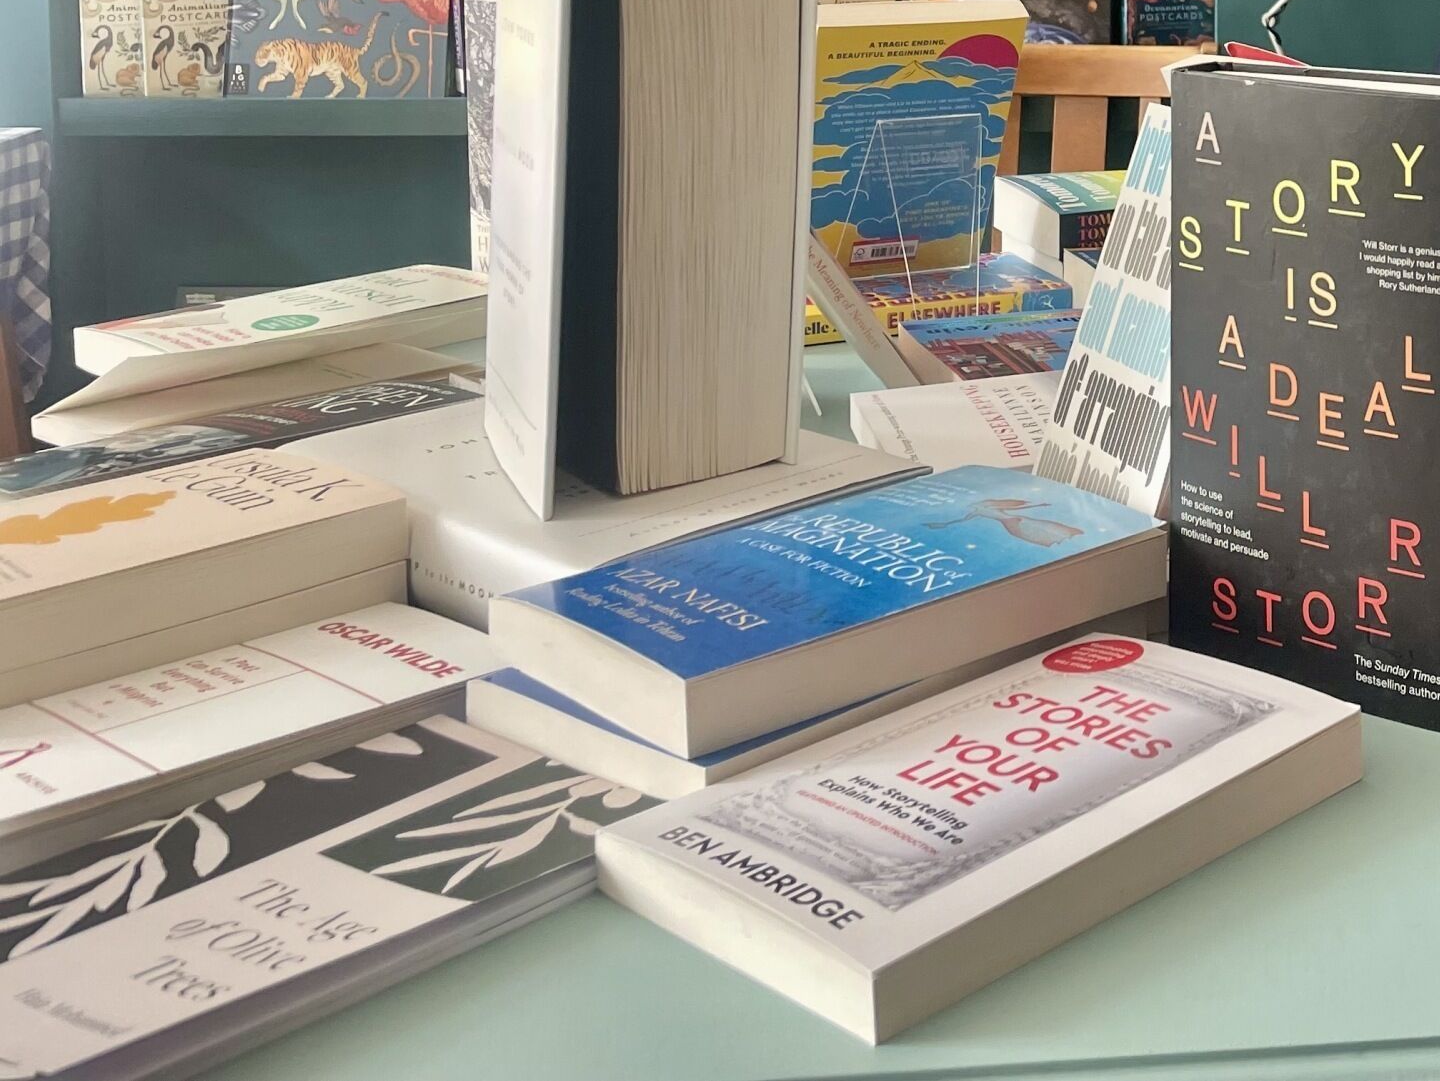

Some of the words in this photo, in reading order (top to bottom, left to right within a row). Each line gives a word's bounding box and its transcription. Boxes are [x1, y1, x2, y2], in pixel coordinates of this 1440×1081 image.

[1140, 12, 1204, 21] POSTCARDS
[836, 51, 885, 59] BEAUTIFUL
[887, 49, 938, 58] BEGINNING.
[878, 40, 910, 48] TRAGIC
[911, 39, 947, 47] ENDING.
[1178, 142, 1425, 260] STORY
[1363, 254, 1386, 264] would
[1387, 255, 1416, 268] happily
[1416, 259, 1435, 269] read
[1378, 241, 1398, 252] Storr
[1287, 267, 1338, 317] IS
[1366, 265, 1401, 280] shopping
[1378, 279, 1398, 292] Rory
[206, 452, 318, 488] Ursula
[1182, 385, 1327, 537] WILL
[145, 465, 201, 484] Le
[185, 475, 275, 511] Guin
[1180, 480, 1199, 494] How
[1180, 511, 1222, 534] storytelling
[1194, 501, 1224, 518] science
[752, 520, 954, 595] IMAGINATION
[803, 513, 955, 574] REPUBLIC
[1180, 526, 1213, 545] motivate
[1230, 542, 1269, 561] persuade
[808, 558, 873, 589] FICTION
[607, 567, 682, 595] AZAR
[675, 587, 769, 632] NAFISI
[316, 620, 390, 653] OSCAR
[383, 642, 467, 682] WILDE
[1353, 653, 1373, 669] The
[1373, 659, 1411, 679] Sunday
[1077, 685, 1172, 724] THE
[1355, 671, 1407, 696] bestselling
[992, 692, 1174, 760] STORIES
[1005, 727, 1081, 754] OF
[896, 760, 1003, 807] LIFE
[934, 734, 1060, 793] YOUR
[817, 777, 877, 805] Explains
[876, 799, 911, 820] Who
[910, 815, 937, 832] We
[934, 829, 965, 846] Are
[848, 775, 884, 792] How
[881, 787, 969, 831] Storytelling
[656, 824, 716, 859] BEN
[707, 844, 865, 933] AMBRIDGE
[237, 877, 314, 923] The
[299, 906, 381, 944] Age
[163, 917, 214, 948] of
[203, 926, 310, 973] Olive
[129, 953, 236, 1004] Trees
